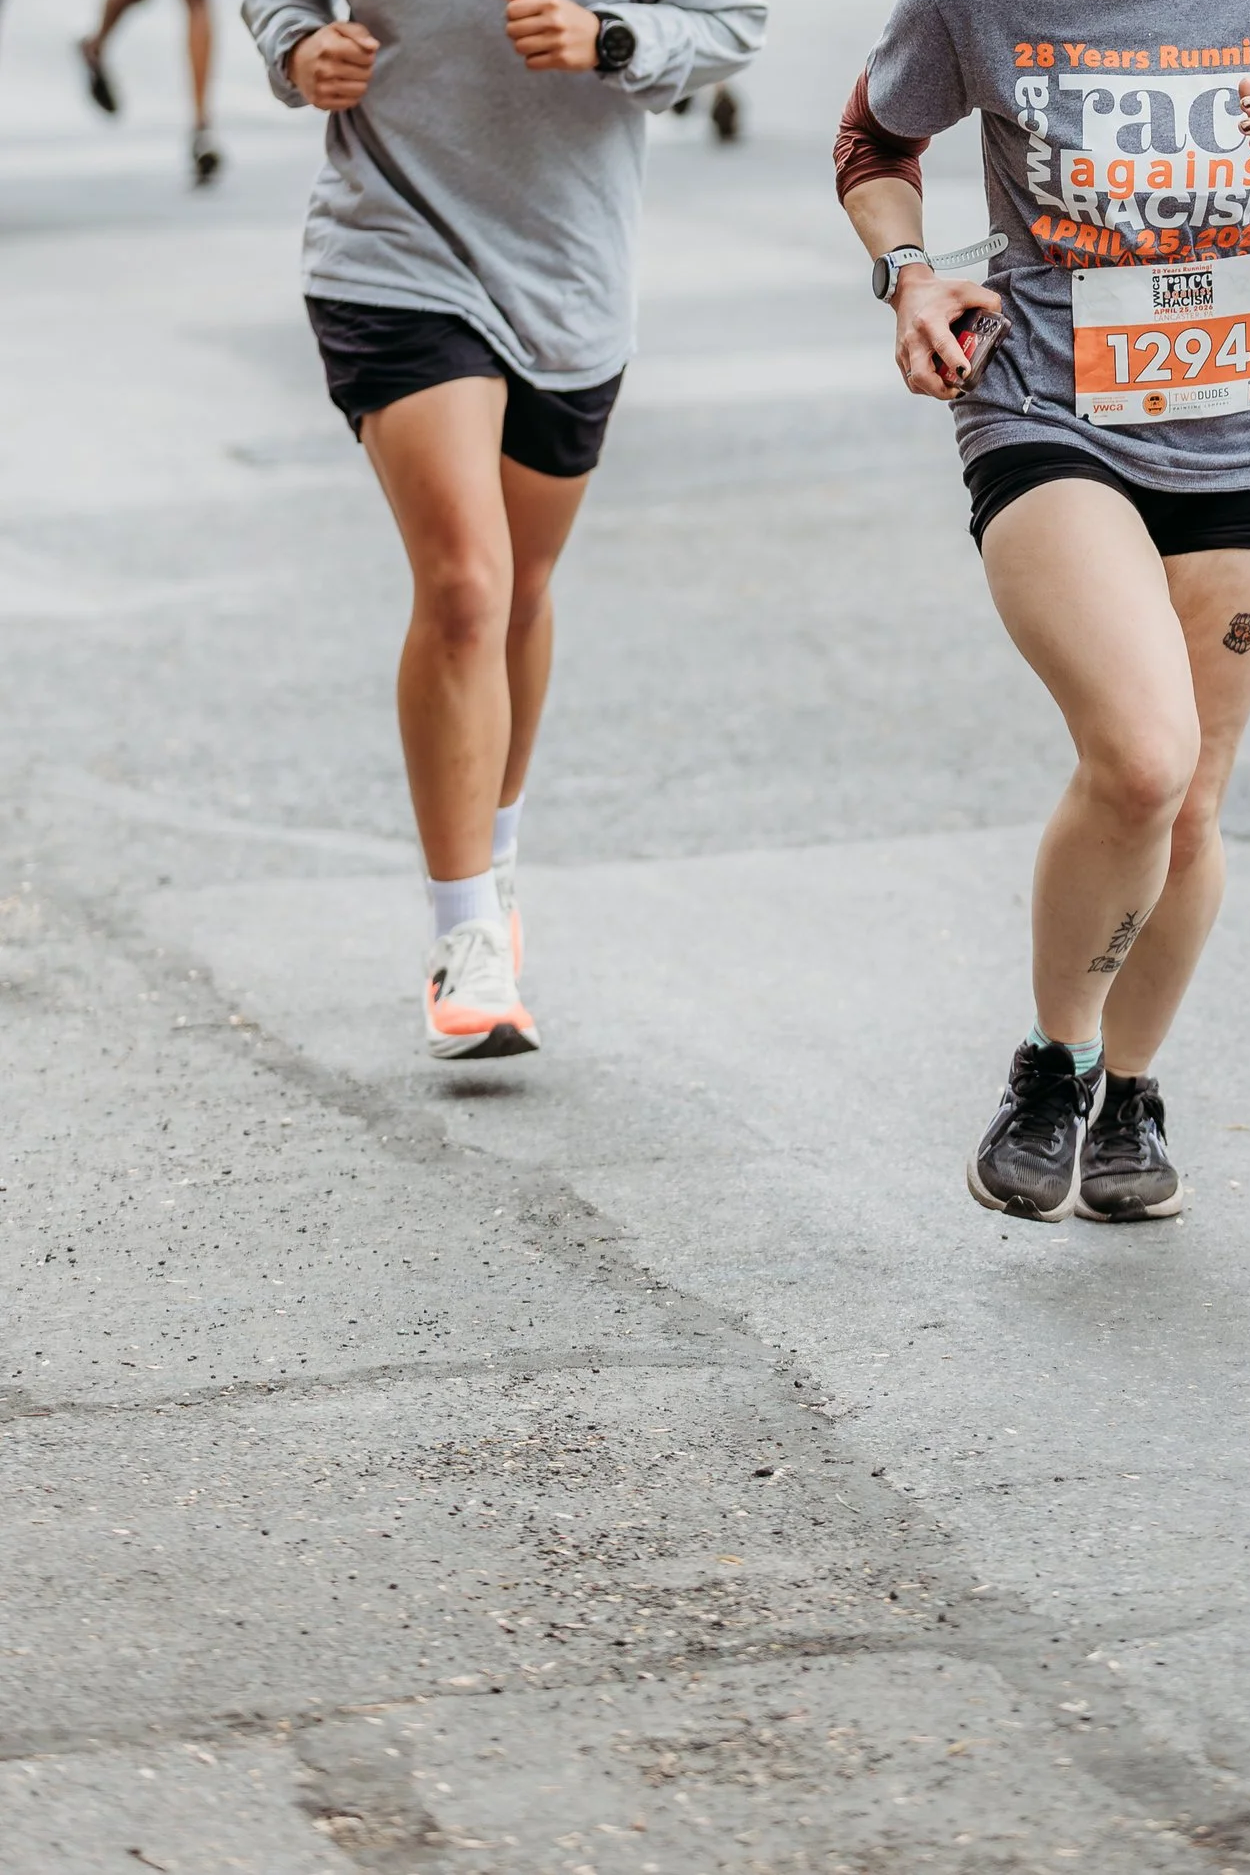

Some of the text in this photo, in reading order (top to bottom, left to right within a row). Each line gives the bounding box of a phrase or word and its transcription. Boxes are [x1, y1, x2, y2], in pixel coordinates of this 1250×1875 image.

[1014, 43, 1055, 68] 28
[1062, 43, 1151, 69] Years
[1015, 75, 1067, 212] ywca
[1030, 215, 1124, 257] APRIL
[1136, 228, 1193, 257] 25,
[1183, 264, 1213, 273] Running!
[1152, 275, 1162, 308] ywca
[1162, 273, 1213, 292] race
[1154, 307, 1177, 315] APRIL
[1163, 295, 1213, 308] RACISM
[1093, 403, 1124, 414] ywca
